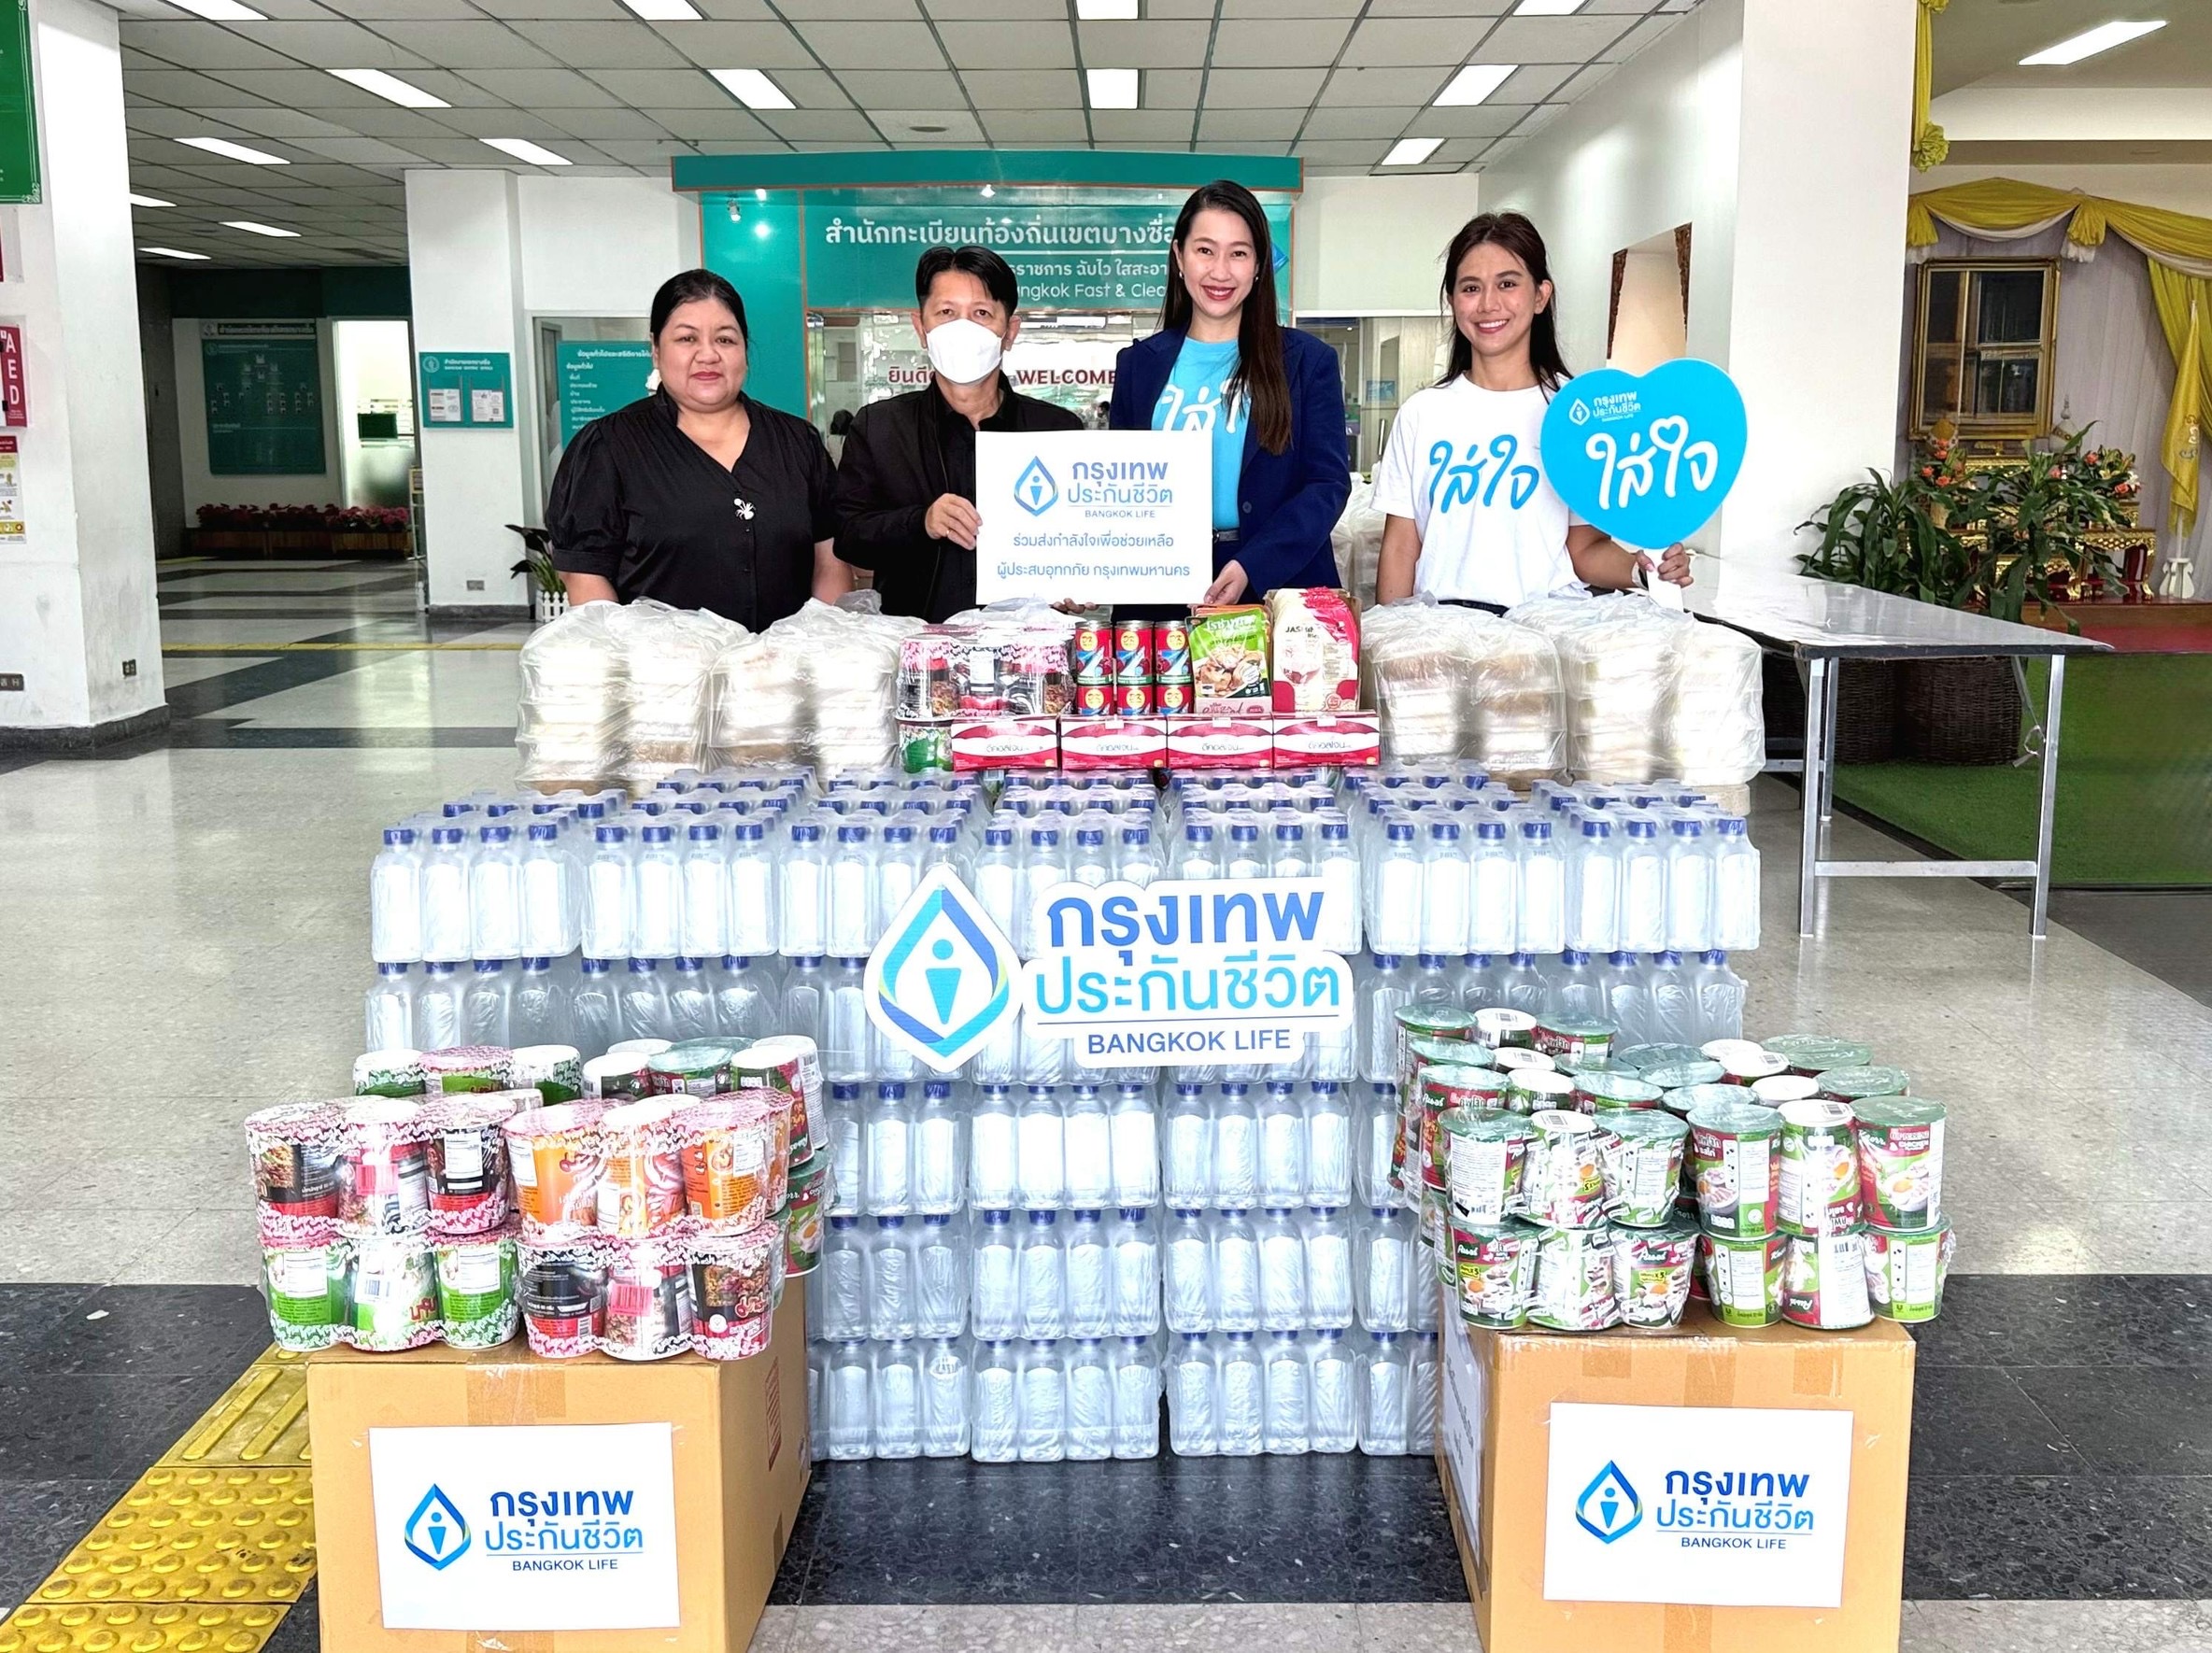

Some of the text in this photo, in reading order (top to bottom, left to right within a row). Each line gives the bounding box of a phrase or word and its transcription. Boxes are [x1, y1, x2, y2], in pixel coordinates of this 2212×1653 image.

[1076, 259, 1112, 276] ฉับไว
[1115, 258, 1168, 276] ใสสะอา
[1017, 284, 1071, 301] ngkok
[1074, 284, 1111, 297] Fast
[1115, 283, 1126, 297] &
[1594, 391, 1638, 408] กรุงเทพ
[1072, 461, 1169, 487] กรุงเทพ
[1429, 434, 1539, 514] ใส่ใจ
[1585, 415, 1719, 510] ใส่ใจ
[1068, 483, 1173, 503] ประกันชีวิต
[1085, 510, 1156, 518] BANGKOK LIFE
[1014, 530, 1174, 547] ร่วมส่งกำลังใจเพื่อช่วยเหลือ
[998, 562, 1190, 579] ผู้ประสบอุทกภัย กรุงเทพมหานคร
[1047, 891, 1324, 967] กรุงเทพ
[1036, 949, 1340, 1015] ประกันชีวิต
[1087, 1029, 1291, 1054] BANGKOK LIFE
[1665, 1469, 1810, 1505] กรุงเทพ
[489, 1490, 634, 1527] กรุงเทพ
[1656, 1500, 1814, 1531] ประกันชีวิต
[485, 1520, 644, 1551] ประกันชีวิต
[1681, 1537, 1786, 1550] BANGKOK LIFE
[512, 1559, 618, 1572] BANGKOK LIFE
